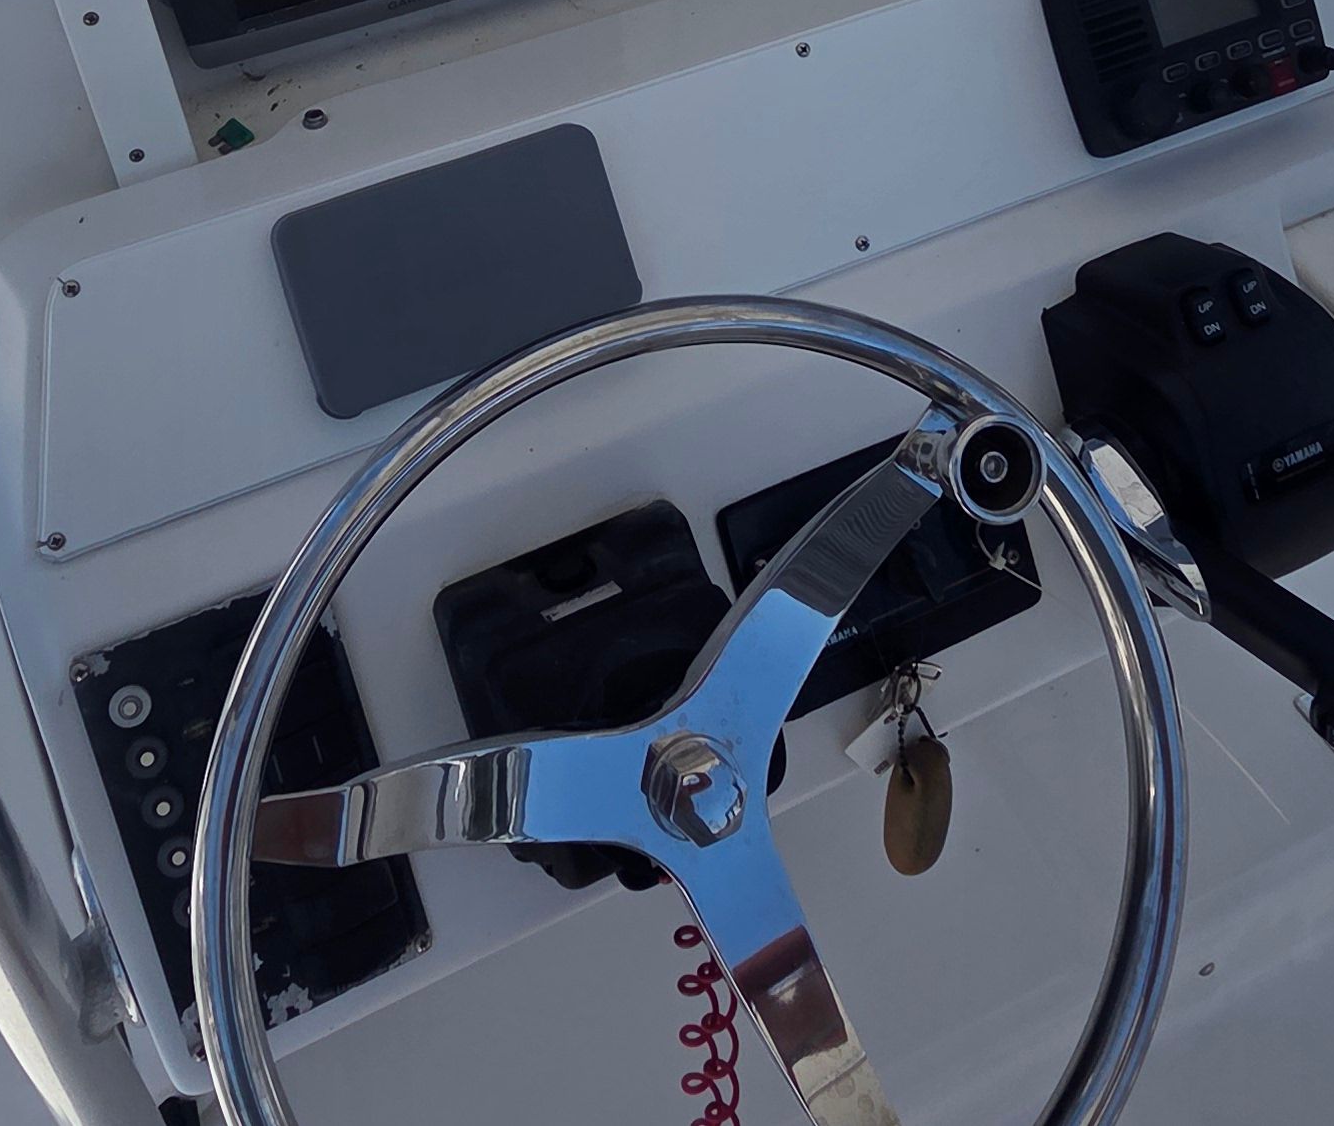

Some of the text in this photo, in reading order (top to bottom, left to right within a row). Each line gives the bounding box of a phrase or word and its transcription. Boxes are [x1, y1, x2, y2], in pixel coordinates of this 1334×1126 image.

[1242, 280, 1257, 294] UP
[1197, 300, 1214, 314] UP
[1249, 300, 1267, 315] DN
[1203, 321, 1221, 336] DN
[1283, 441, 1324, 468] YAMAHA
